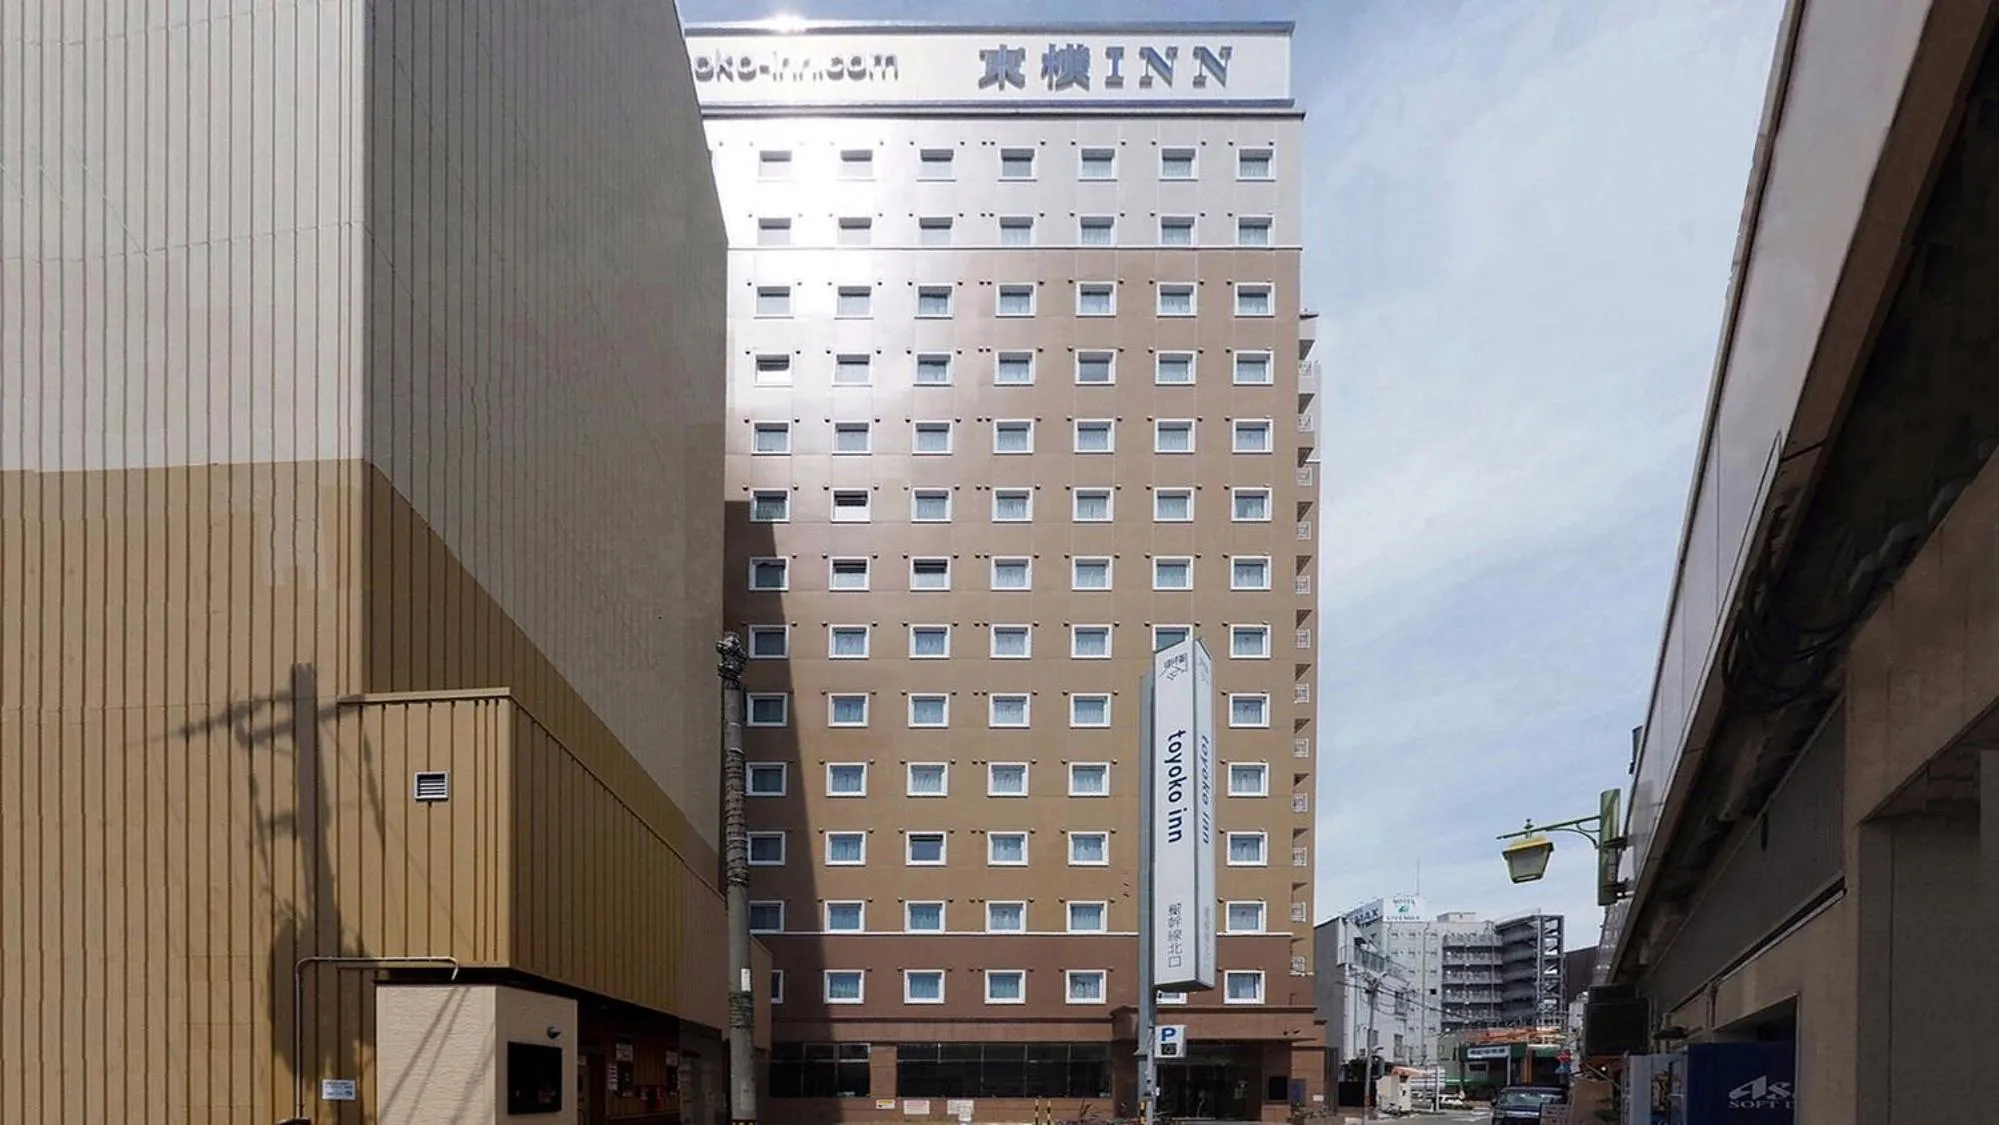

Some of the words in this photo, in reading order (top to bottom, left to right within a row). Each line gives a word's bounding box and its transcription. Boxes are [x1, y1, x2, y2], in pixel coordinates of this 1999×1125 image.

[1164, 729, 1188, 803] toyoko
[1200, 735, 1210, 806] toyoko
[1168, 807, 1188, 843] inn
[1202, 811, 1211, 844] inn
[1161, 1027, 1177, 1042] P
[1728, 1075, 1795, 1100] As
[1729, 1100, 1779, 1109] SOFT
